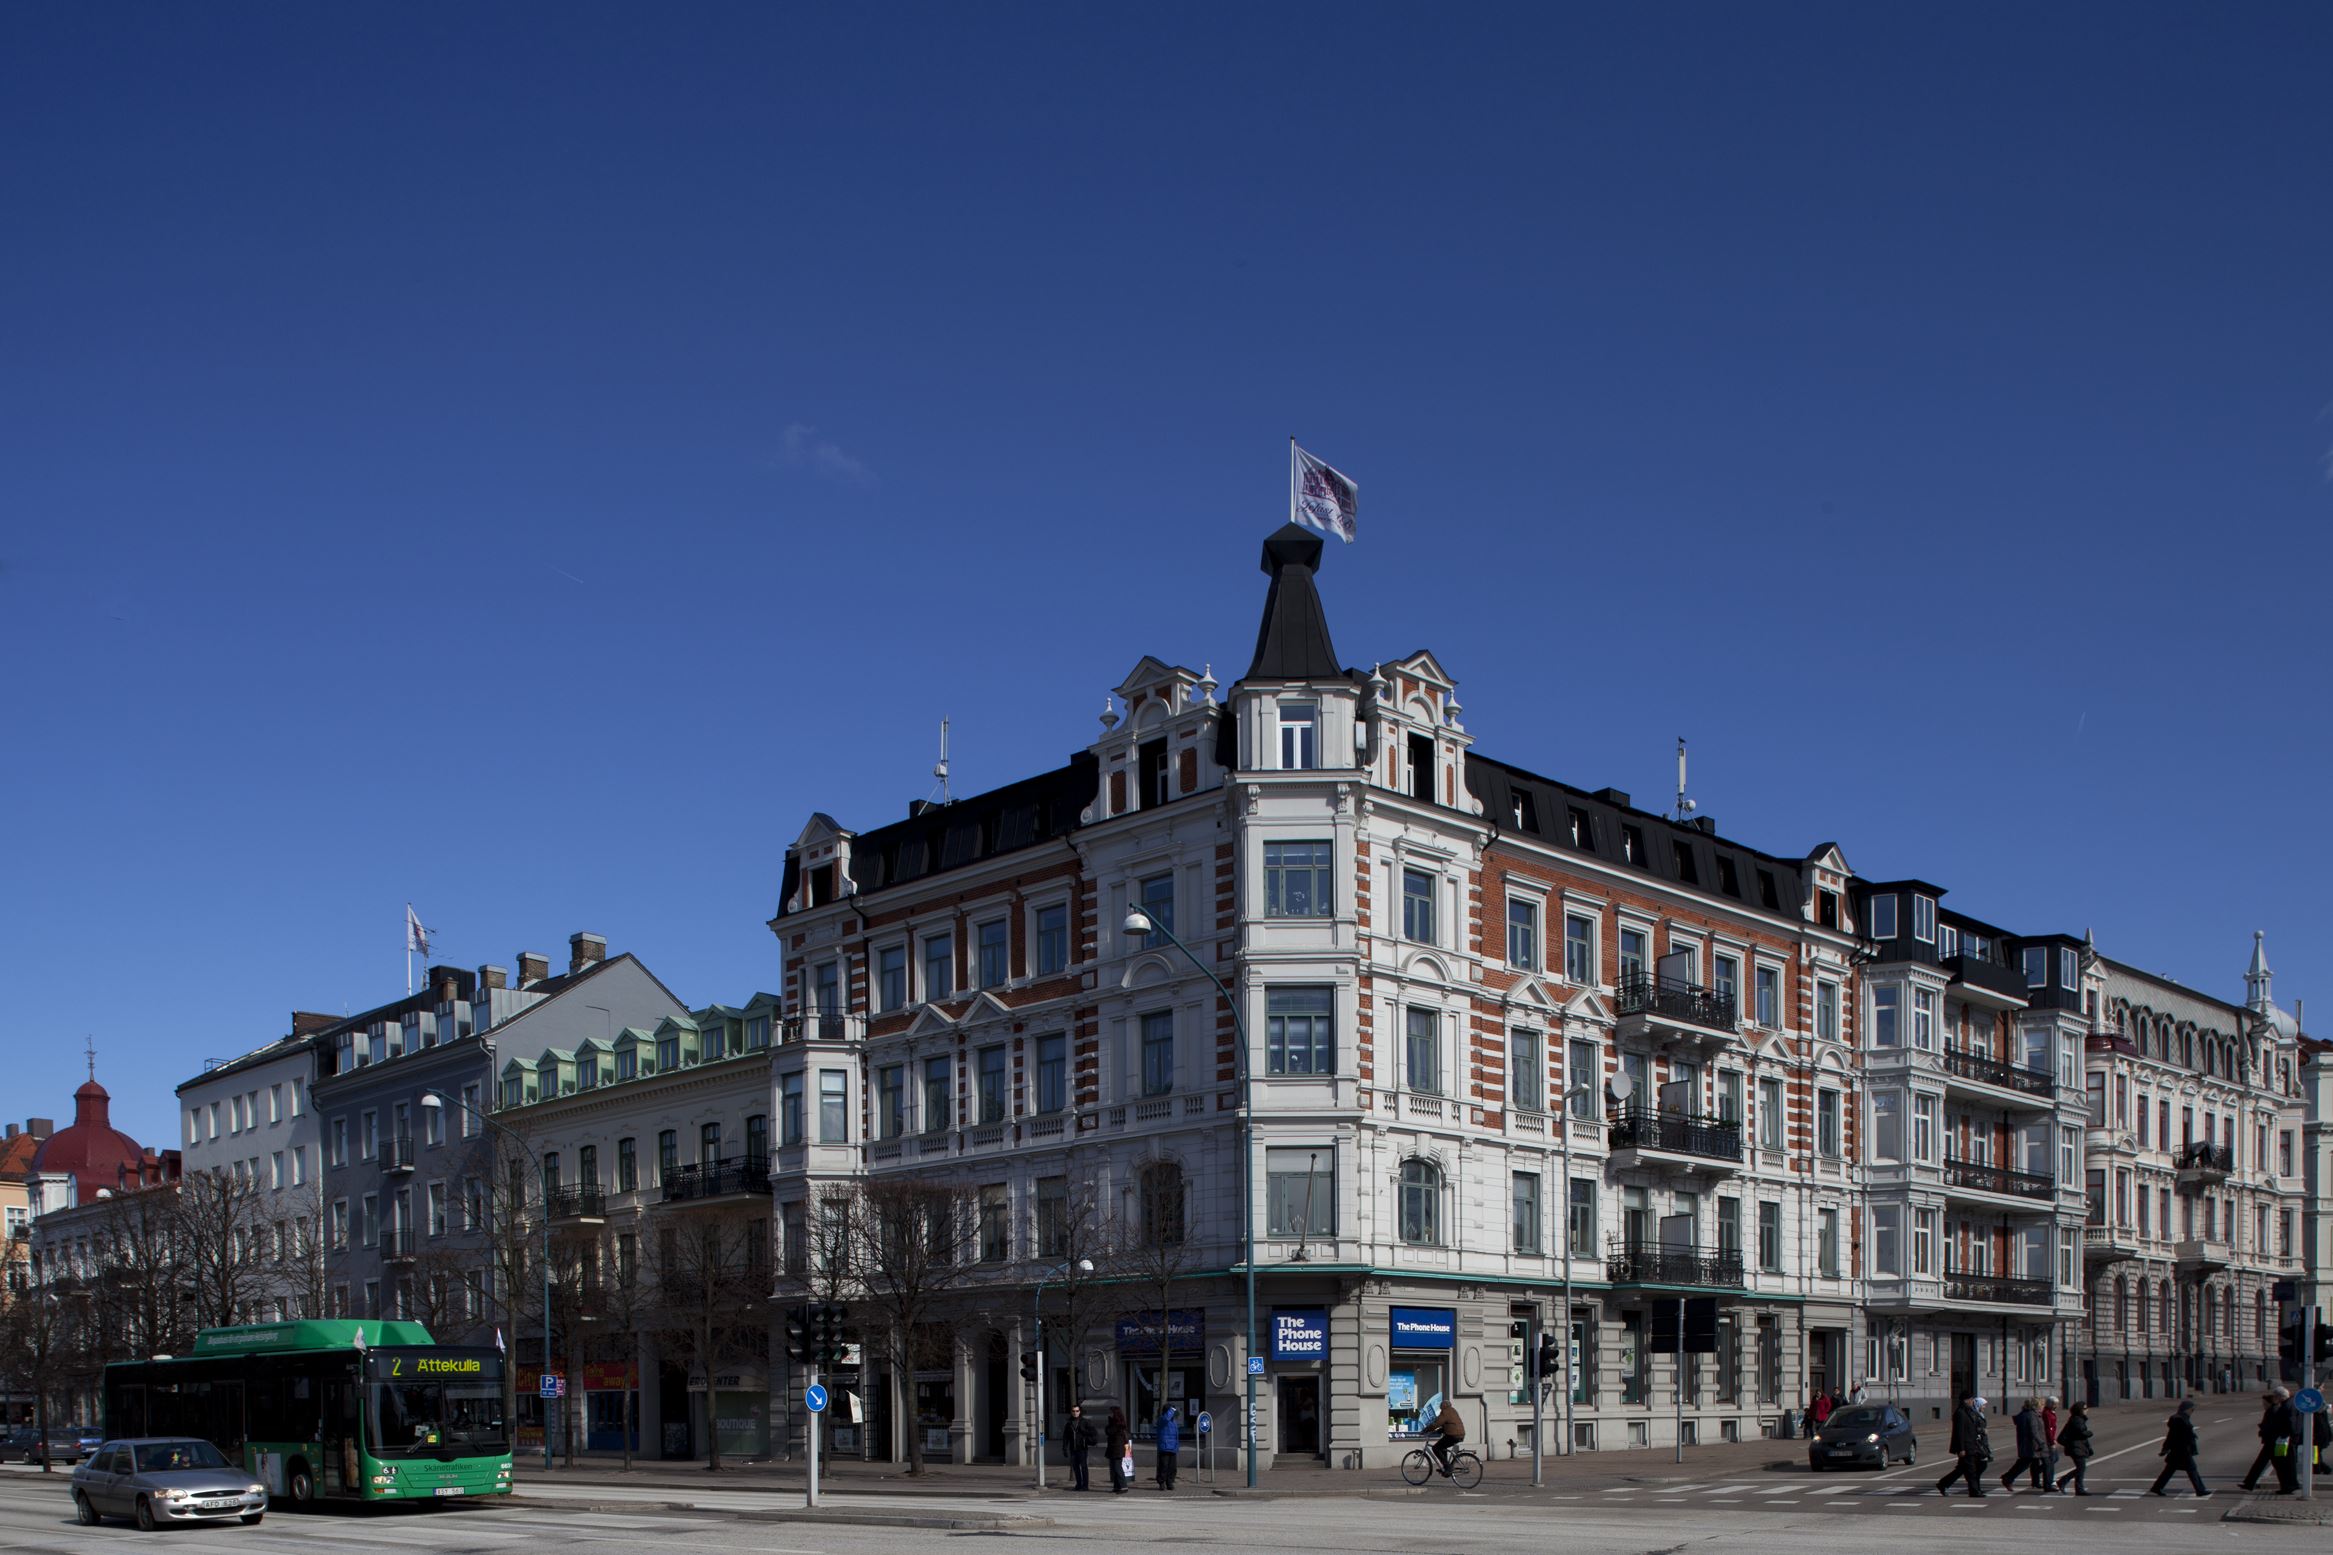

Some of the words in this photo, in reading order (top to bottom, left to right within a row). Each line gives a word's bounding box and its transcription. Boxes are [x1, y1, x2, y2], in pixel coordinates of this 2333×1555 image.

[1277, 1316, 1305, 1328] The
[1396, 1322, 1410, 1331] The
[1410, 1322, 1430, 1331] Phone
[1430, 1323, 1450, 1332] House
[1278, 1328, 1322, 1340] Phone
[1278, 1340, 1322, 1351] House
[392, 1357, 402, 1377] 2
[417, 1358, 481, 1372] Ättekulla
[545, 1377, 554, 1388] P
